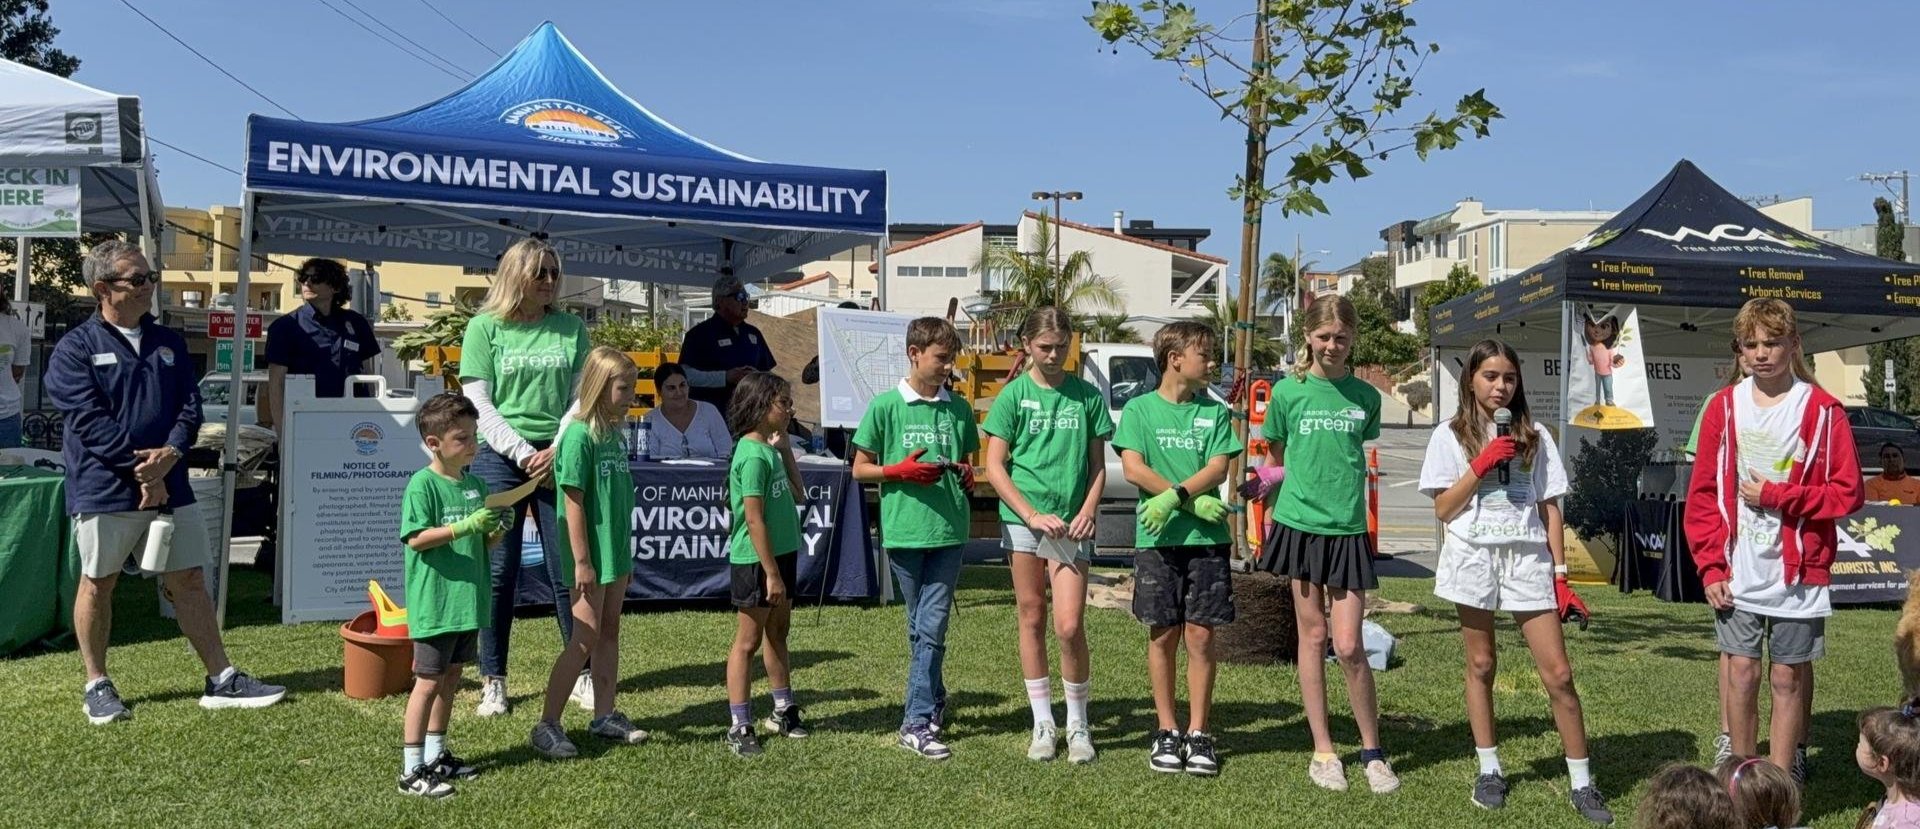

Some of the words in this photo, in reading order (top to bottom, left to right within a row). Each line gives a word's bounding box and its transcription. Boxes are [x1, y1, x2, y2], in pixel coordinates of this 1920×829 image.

[45, 168, 69, 185] IN
[268, 141, 600, 196] ENVIRONMENTAL
[610, 169, 870, 215] SUSTAINABILITY
[0, 189, 44, 206] ERE
[1637, 224, 1798, 248] WCA
[1672, 244, 1707, 252] Tree
[1600, 260, 1620, 272] Tree
[1621, 261, 1654, 276] Pruning
[1748, 267, 1767, 279] Tree
[1768, 268, 1804, 281] Removal
[1600, 279, 1620, 290] Tree
[1622, 280, 1662, 295] Inventory
[1892, 273, 1912, 287] Tree
[1749, 285, 1784, 298] Arborist
[1785, 286, 1822, 300] Services
[211, 316, 221, 324] DO
[223, 316, 235, 324] NO
[218, 326, 233, 334] EXIT
[1029, 417, 1080, 435] green
[1299, 417, 1355, 436] green
[902, 431, 952, 449] green
[343, 462, 376, 470] NOTICE
[378, 462, 390, 470] OF
[311, 470, 417, 480] FILMING/PHOTOGRAPH
[642, 486, 667, 501] OF
[1879, 561, 1902, 573] INC.
[1857, 582, 1886, 591] services
[1887, 580, 1898, 589] for
